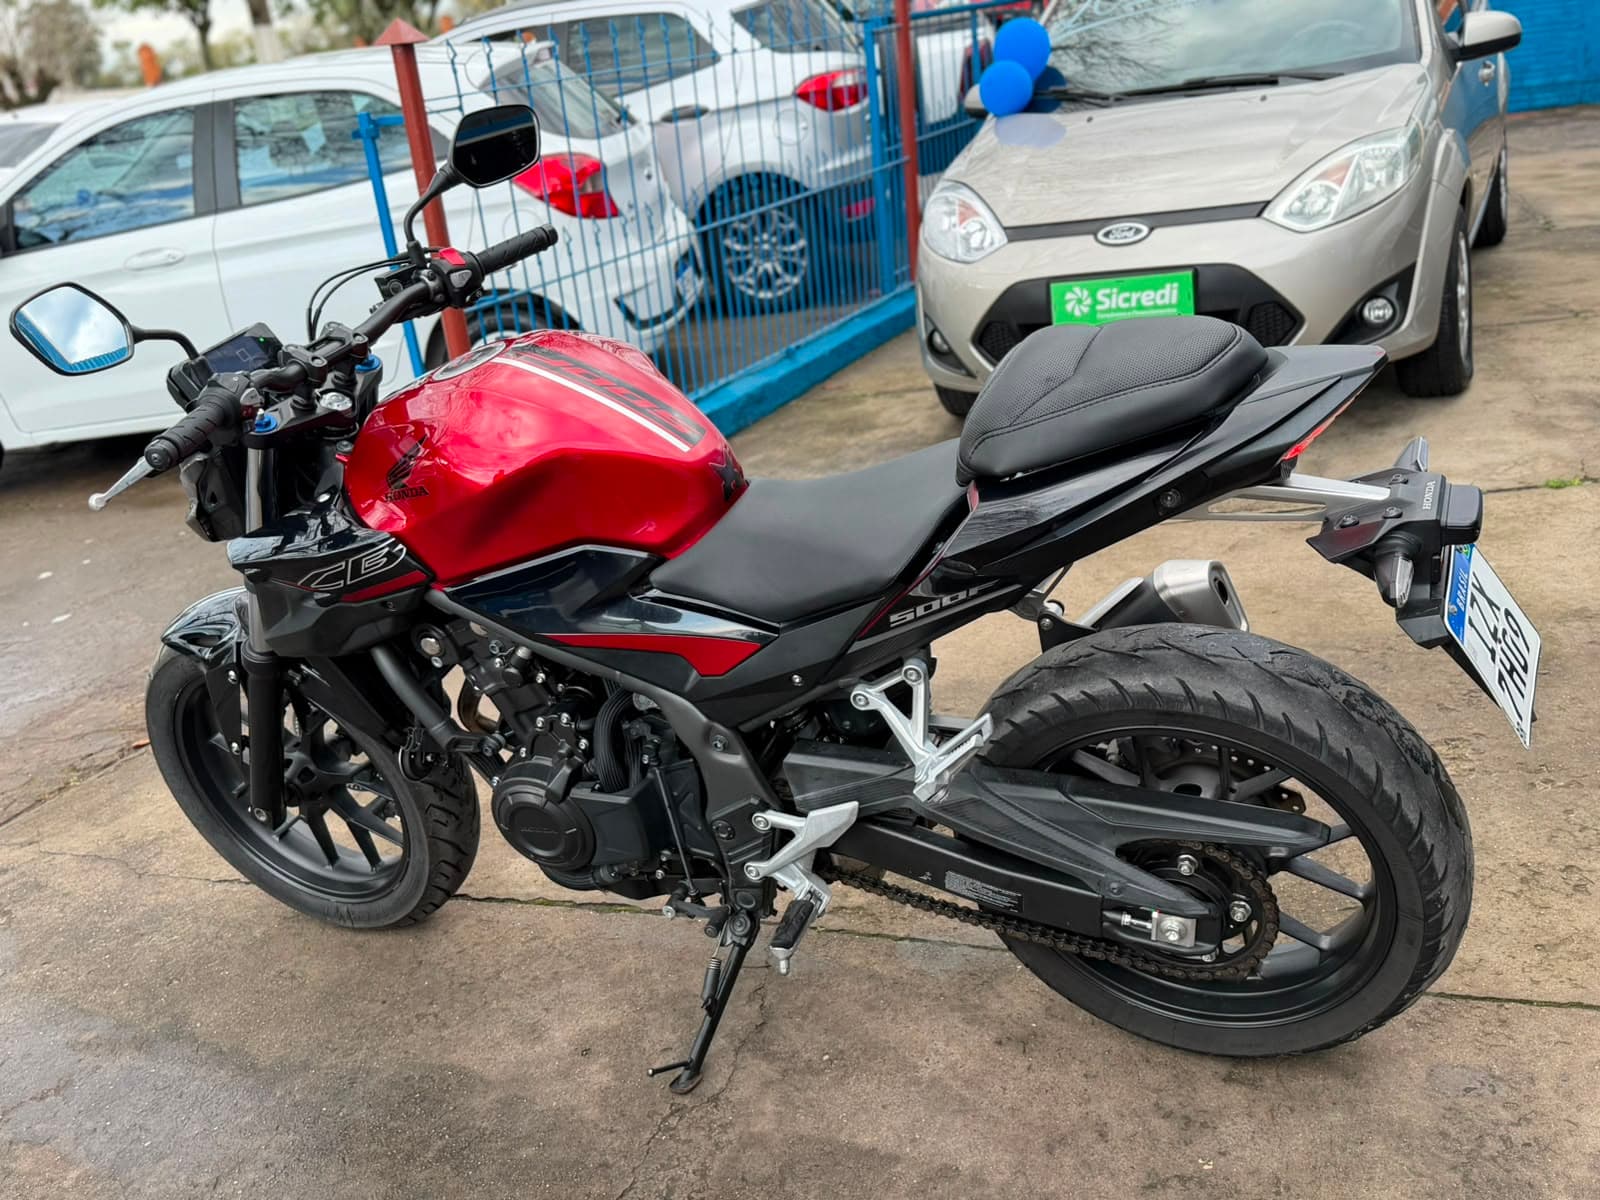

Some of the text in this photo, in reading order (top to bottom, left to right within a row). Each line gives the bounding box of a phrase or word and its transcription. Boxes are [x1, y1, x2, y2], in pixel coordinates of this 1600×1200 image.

[1096, 283, 1179, 311] Sicredi
[1422, 480, 1436, 510] HONDA
[297, 537, 407, 590] CB
[1456, 567, 1468, 613] BRASIL
[1468, 571, 1502, 664] IZX
